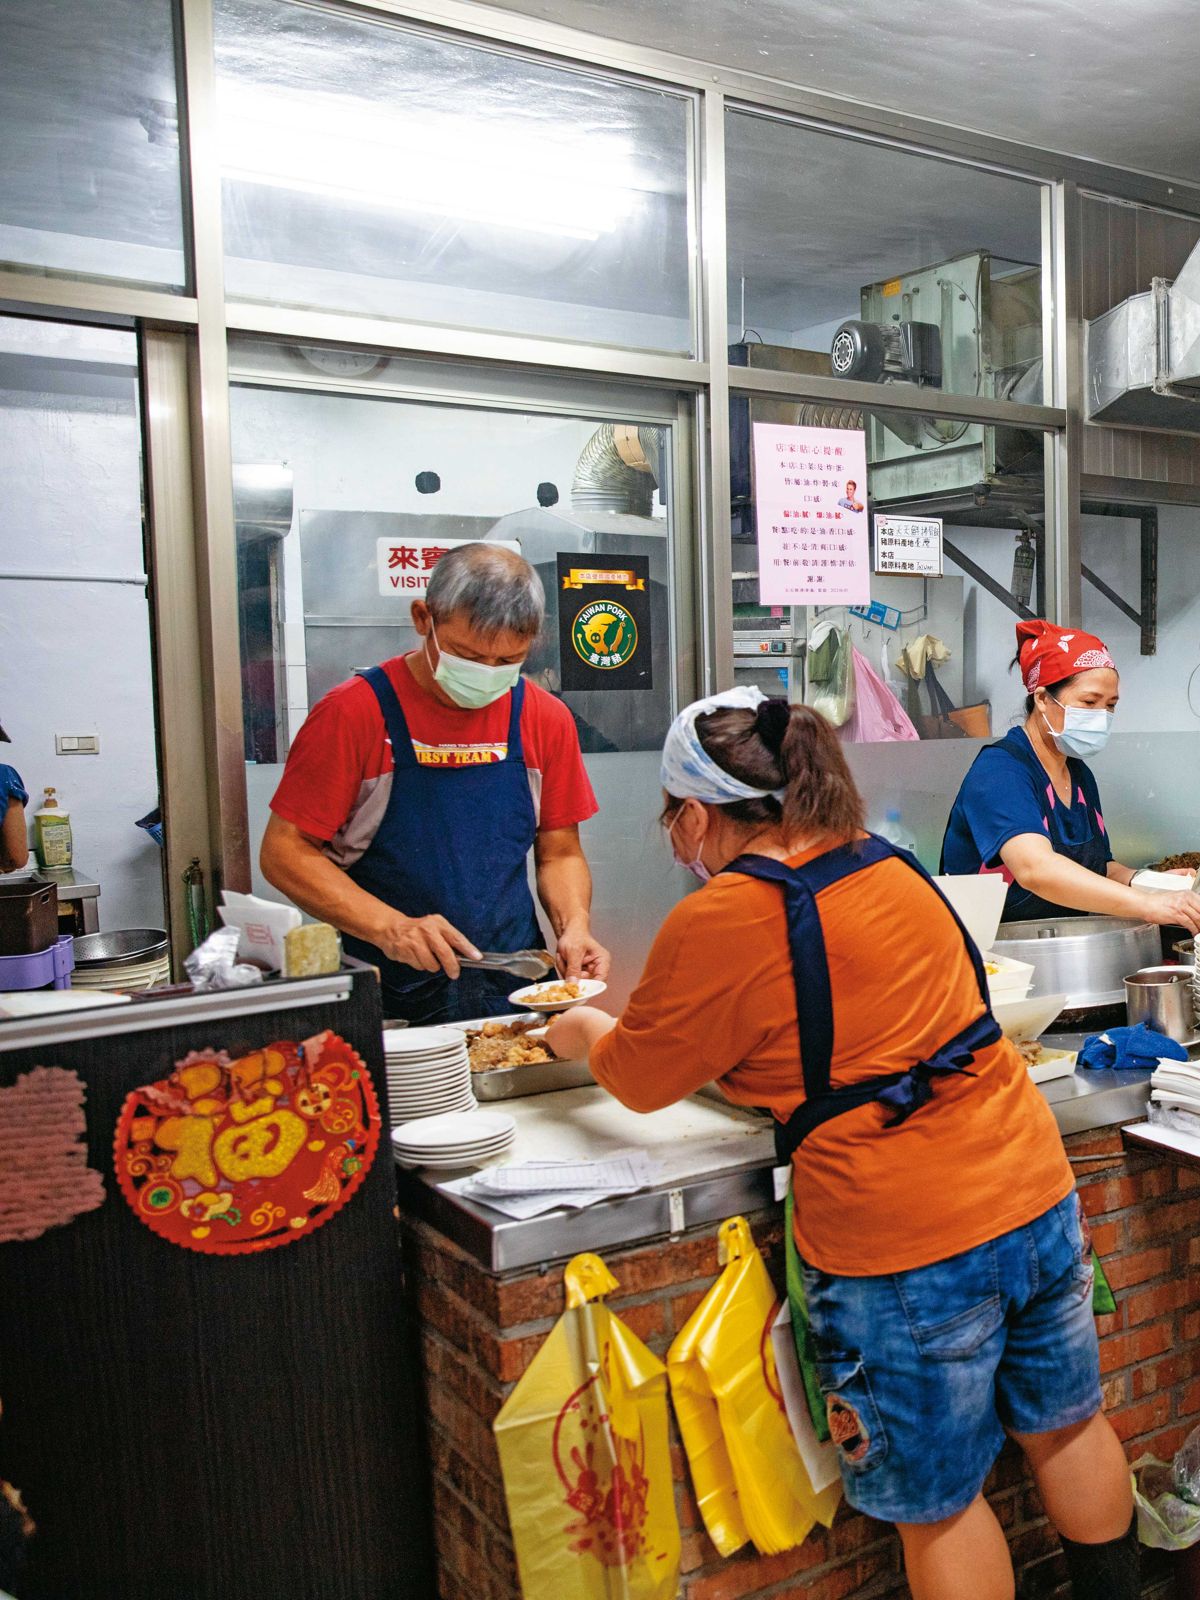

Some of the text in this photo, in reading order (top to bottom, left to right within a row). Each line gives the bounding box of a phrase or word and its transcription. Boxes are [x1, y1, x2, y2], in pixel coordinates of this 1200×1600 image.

[880, 528, 894, 536] 本店
[880, 537, 914, 548] 豬原料產地
[880, 551, 894, 560] 本店
[881, 561, 915, 571] 豬原料產地
[578, 603, 628, 624] TAIWAN PORK
[455, 751, 492, 763] TEAM
